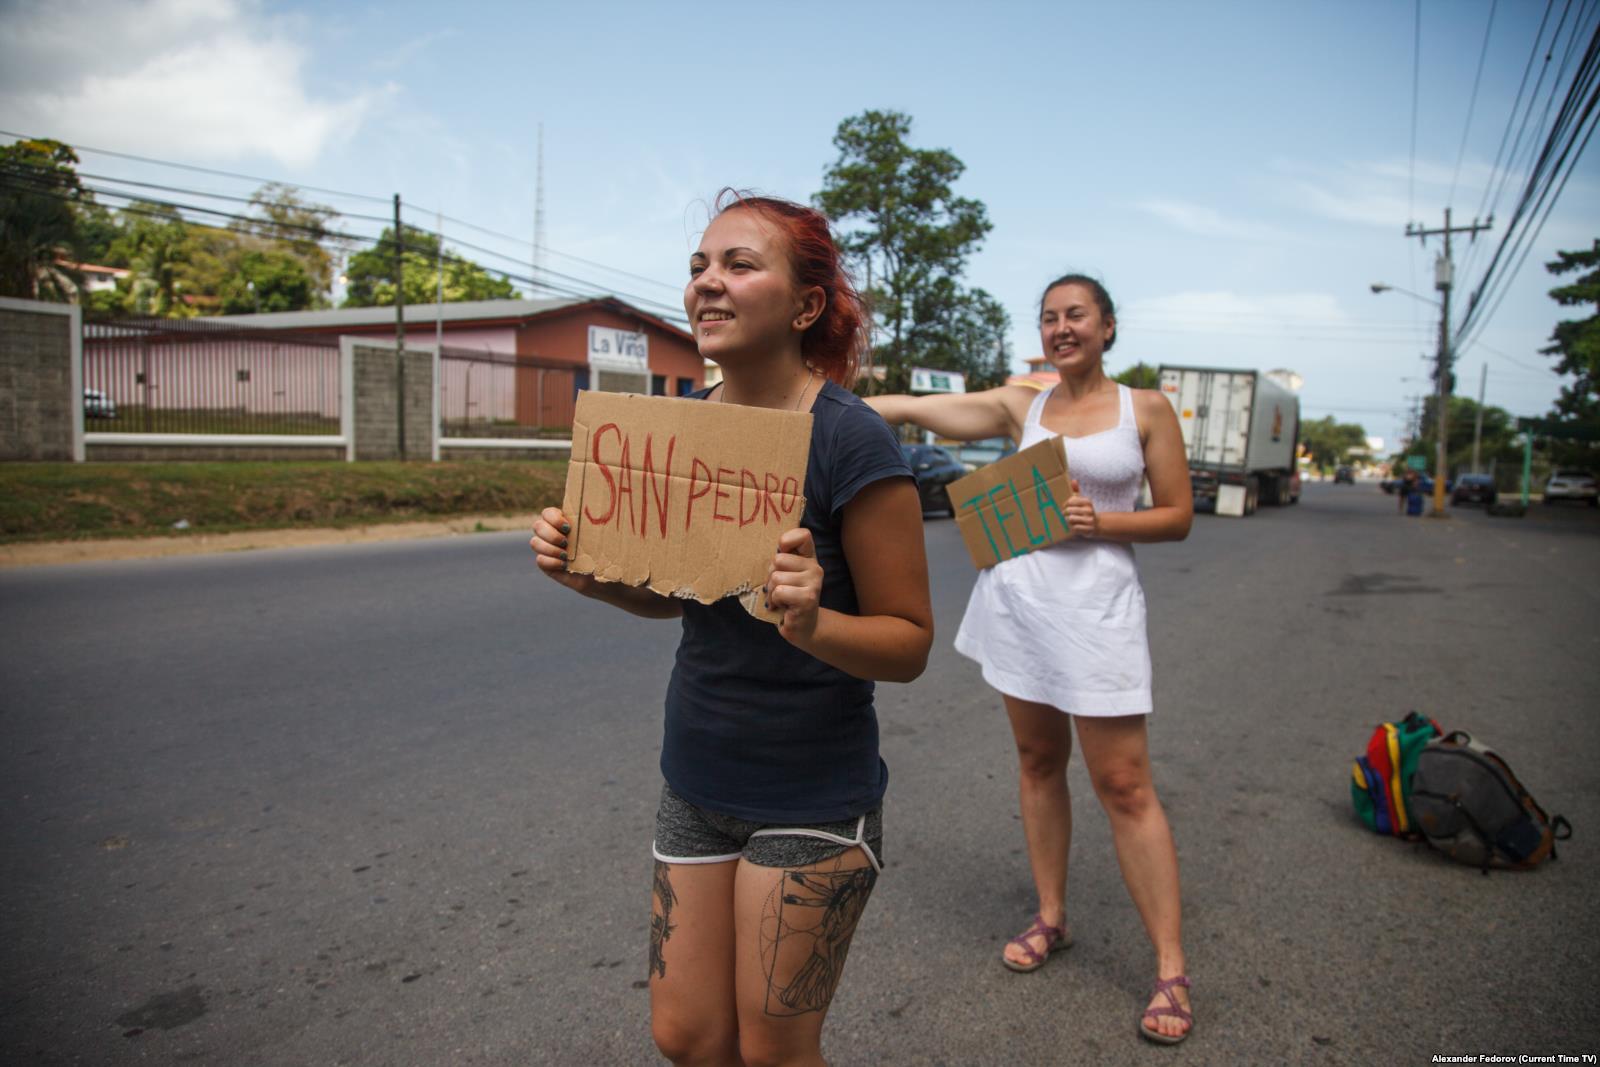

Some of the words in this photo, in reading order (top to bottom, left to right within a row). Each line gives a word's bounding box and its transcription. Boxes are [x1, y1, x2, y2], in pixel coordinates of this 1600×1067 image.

[591, 329, 609, 353] La
[584, 422, 677, 540] SAN
[686, 456, 799, 533] PEDRO
[960, 463, 1070, 562] TELA
